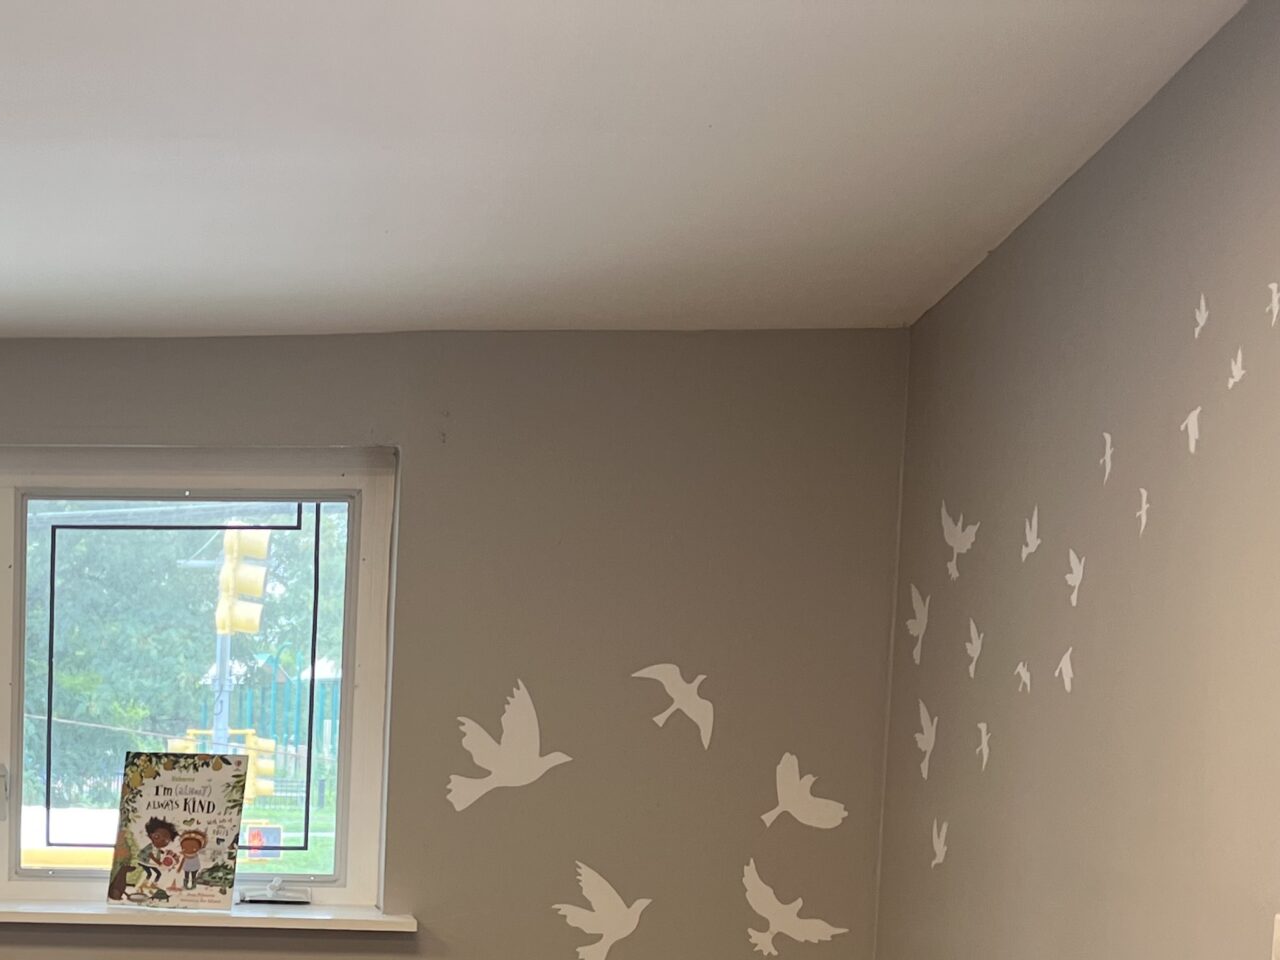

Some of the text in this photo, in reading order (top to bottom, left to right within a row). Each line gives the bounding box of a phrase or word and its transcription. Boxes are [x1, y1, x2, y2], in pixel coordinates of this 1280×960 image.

[154, 785, 173, 797] I'm
[146, 797, 216, 815] ALWAYS KIND
